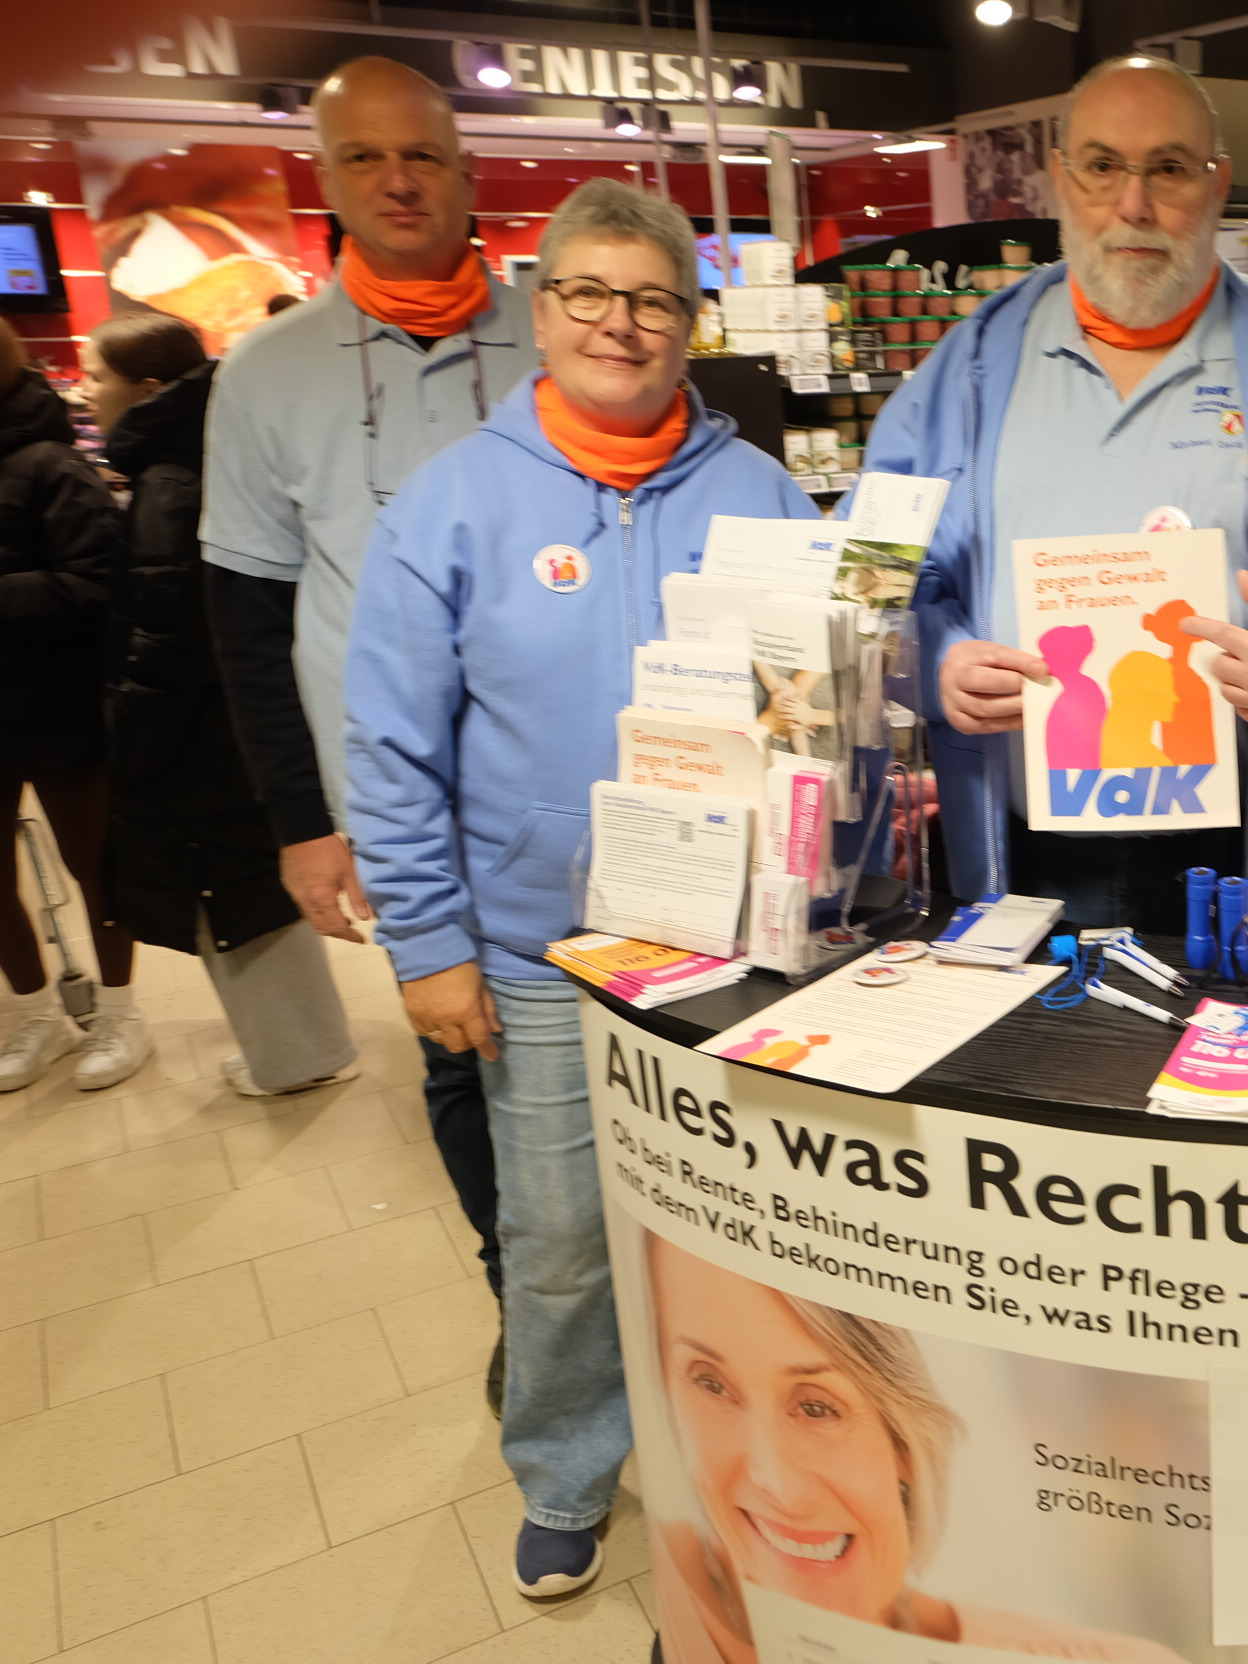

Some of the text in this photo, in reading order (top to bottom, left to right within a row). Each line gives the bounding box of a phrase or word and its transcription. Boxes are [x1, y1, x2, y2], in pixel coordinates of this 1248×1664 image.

[1032, 549, 1151, 568] Gemeinsam
[1034, 566, 1168, 594] gegen Gewalt
[1035, 593, 1140, 612] an Frauen.
[630, 728, 713, 753] Gemeinsam
[632, 752, 725, 777] gegen Gewalt
[632, 772, 650, 785] an
[1048, 763, 1217, 818] VdK
[604, 1029, 758, 1170] Alles,
[770, 1117, 930, 1199] was
[611, 1117, 637, 1155] Ob
[640, 1137, 673, 1178] bei
[680, 1156, 767, 1220] Rente,
[771, 1192, 988, 1279] Behinderung
[998, 1252, 1088, 1288] oder
[1100, 1262, 1227, 1309] Pflege
[615, 1158, 648, 1198] mit
[650, 1177, 701, 1227] dem
[702, 1203, 763, 1252] VdK
[770, 1230, 954, 1305] bekommen
[964, 1282, 1033, 1326] Sie,
[1039, 1302, 1113, 1335] was
[1126, 1309, 1241, 1349] Ihnen
[1033, 1441, 1212, 1493] Sozialrechts
[1036, 1487, 1153, 1525] größten
